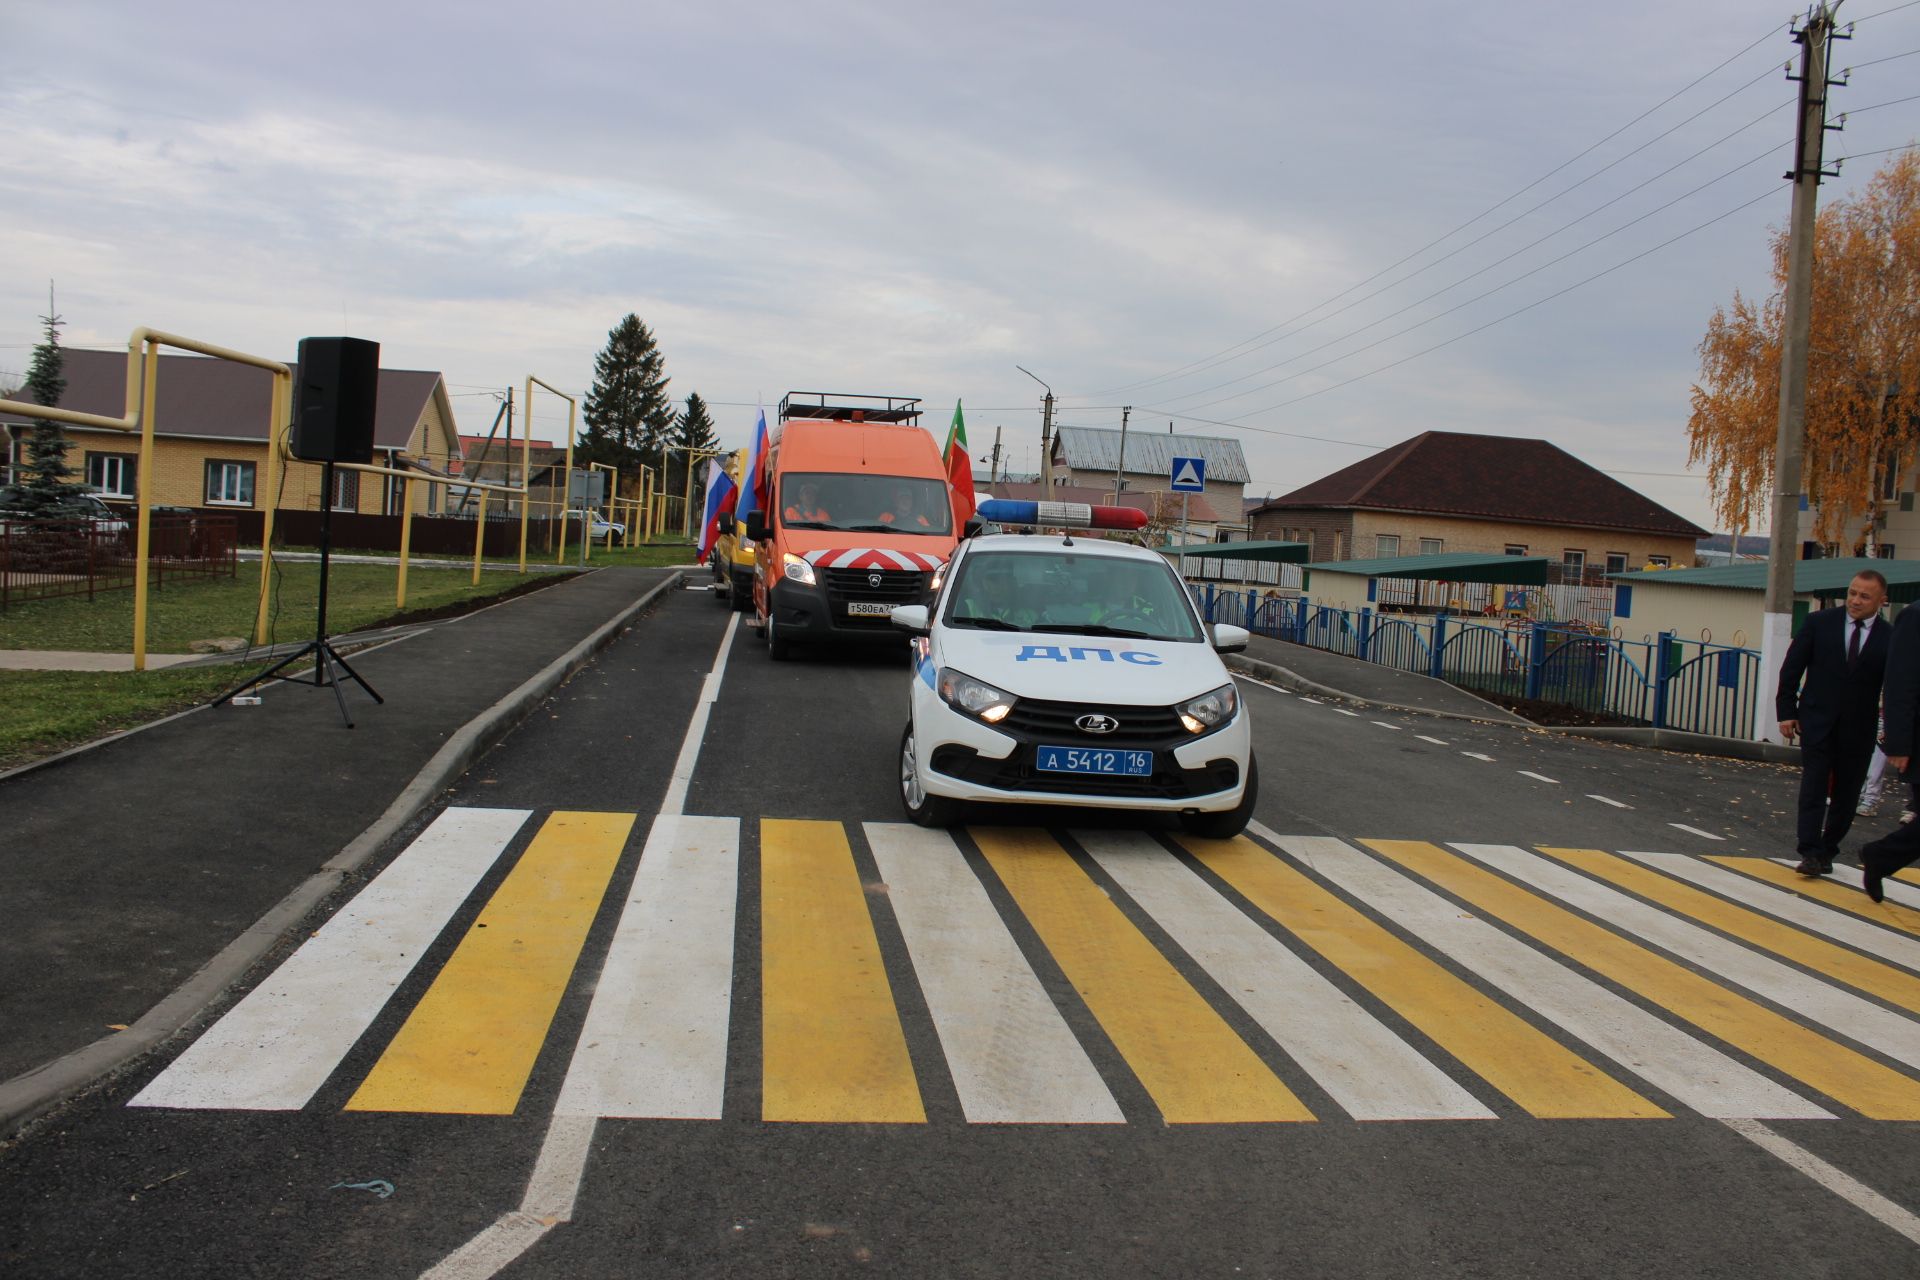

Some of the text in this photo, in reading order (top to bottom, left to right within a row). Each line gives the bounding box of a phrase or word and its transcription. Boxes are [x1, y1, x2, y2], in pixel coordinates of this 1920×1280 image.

[1015, 645, 1163, 665] ДПС
[1066, 750, 1115, 771] 5412
[1128, 753, 1146, 767] 16
